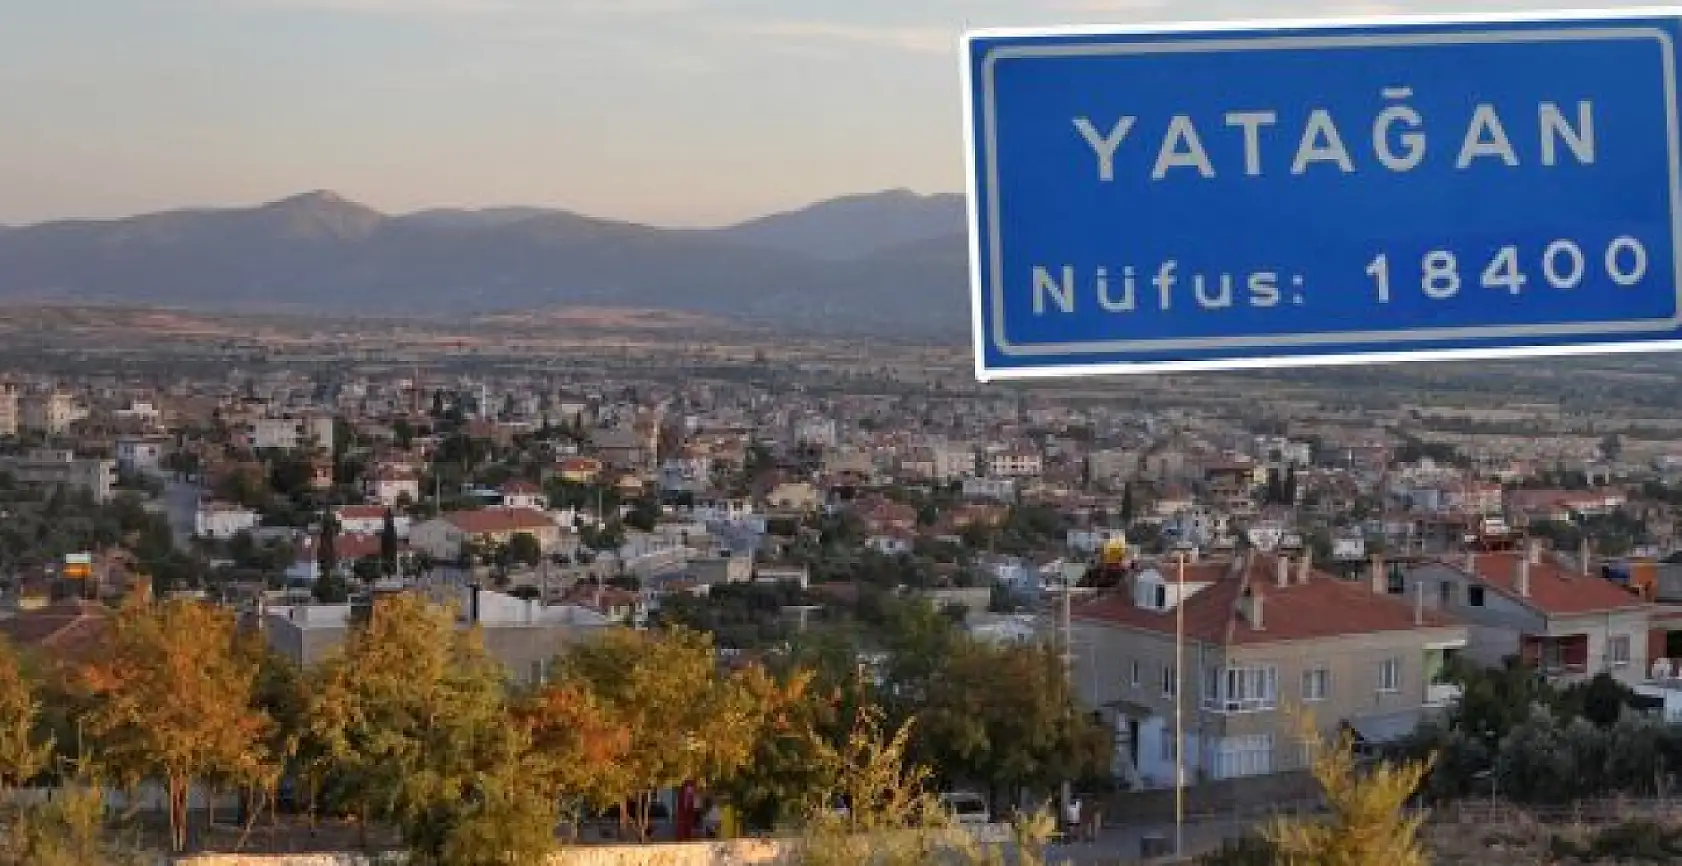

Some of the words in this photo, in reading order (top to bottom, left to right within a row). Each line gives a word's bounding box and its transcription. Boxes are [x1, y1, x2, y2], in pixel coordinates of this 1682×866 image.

[1073, 87, 1596, 181] YATAĞAN
[1031, 260, 1305, 314] Nüfus:
[1366, 236, 1648, 304] 18400
